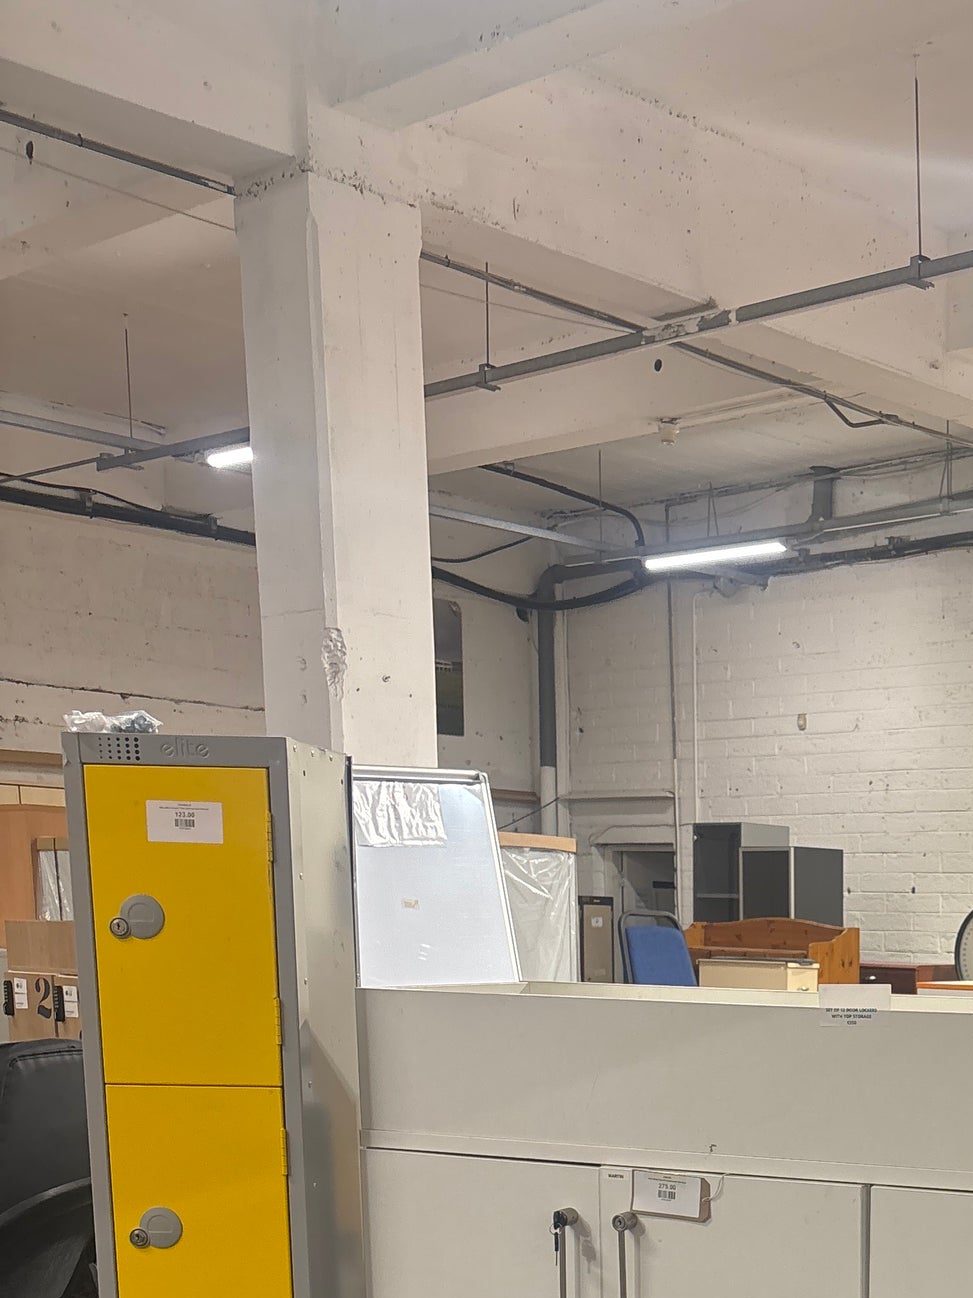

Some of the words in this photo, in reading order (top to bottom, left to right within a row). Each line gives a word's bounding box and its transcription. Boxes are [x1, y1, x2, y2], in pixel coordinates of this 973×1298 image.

[161, 737, 210, 759] elite
[35, 977, 52, 1019] 2
[658, 1183, 676, 1191] 275.00
